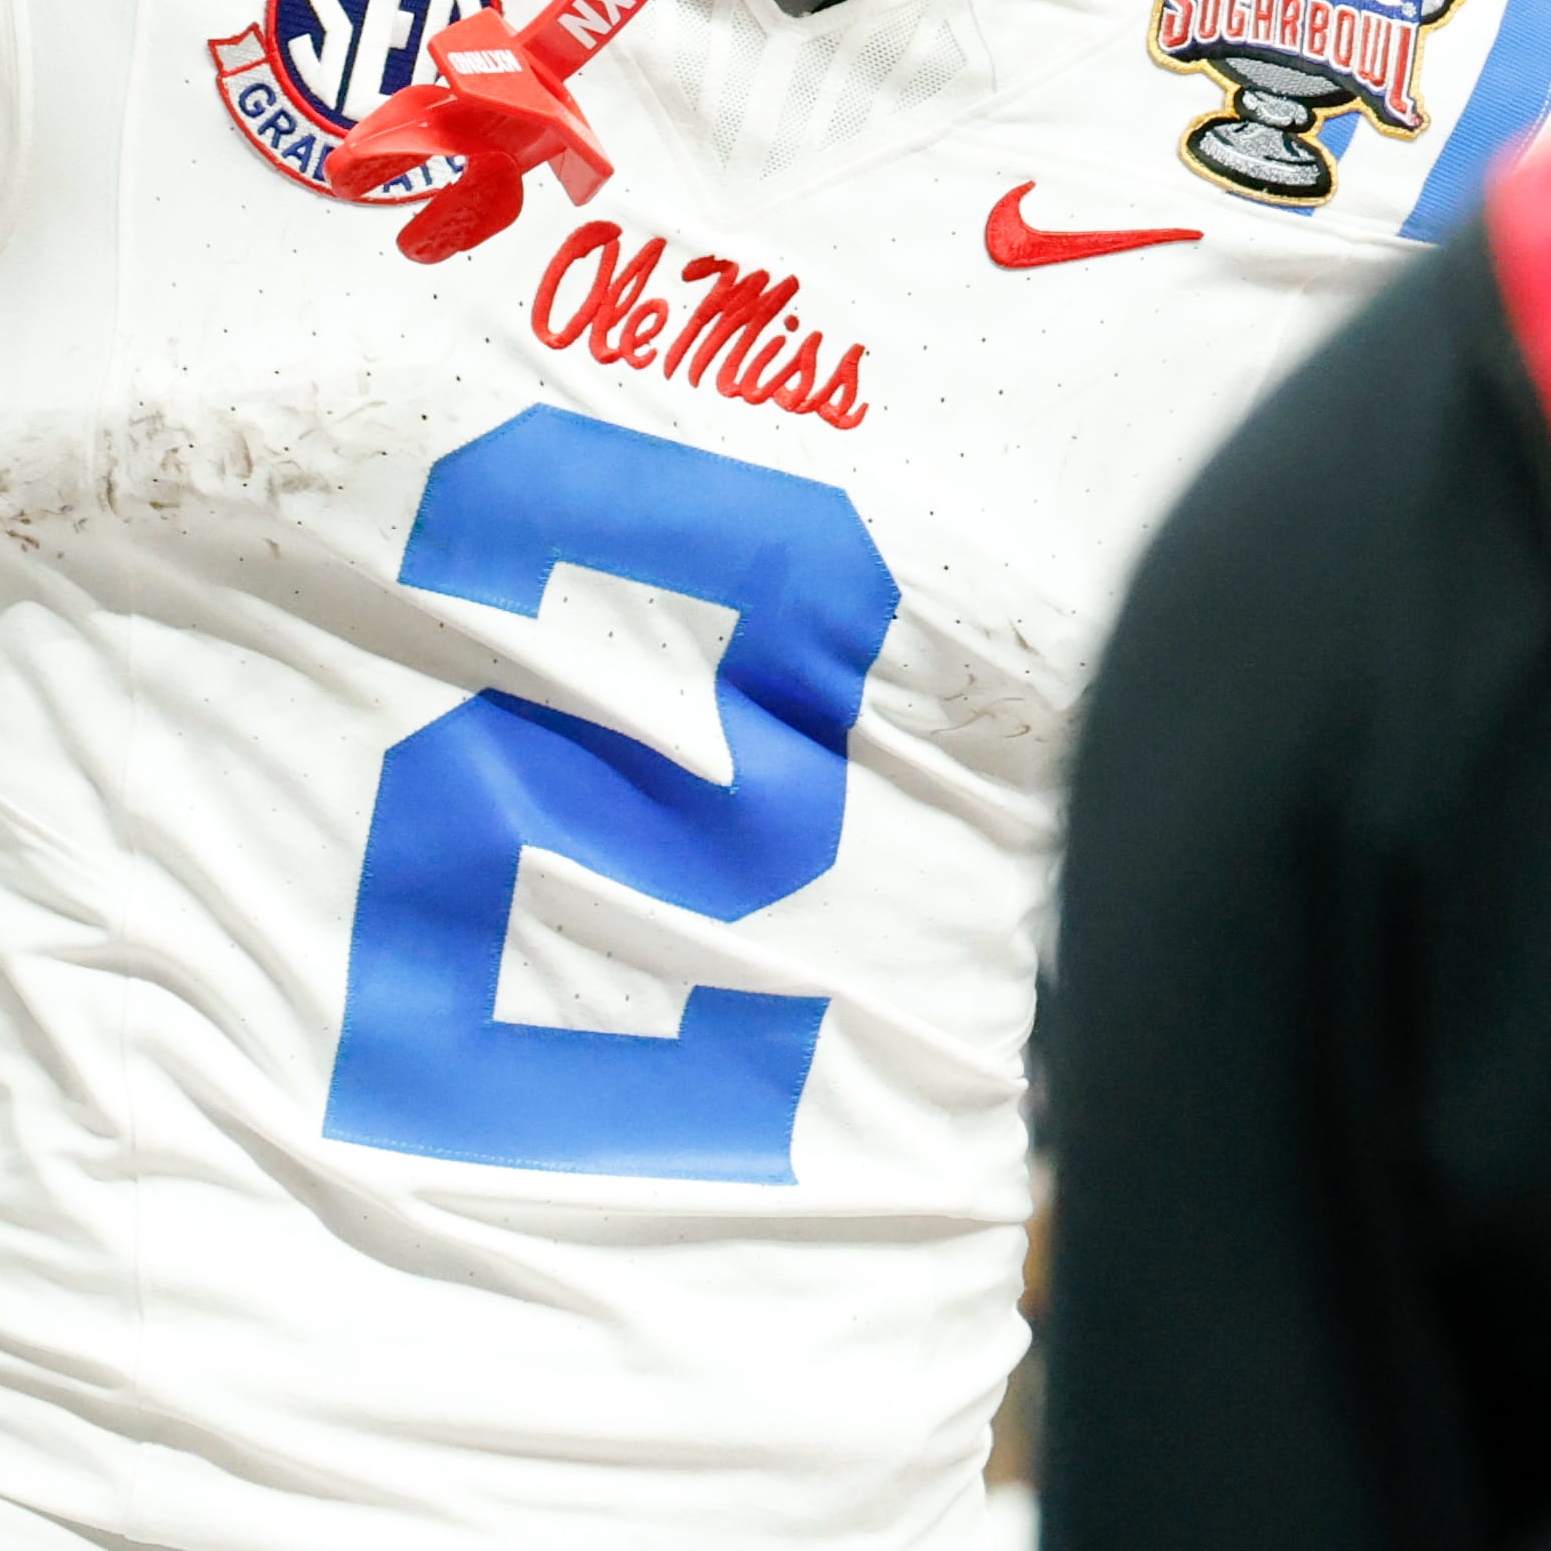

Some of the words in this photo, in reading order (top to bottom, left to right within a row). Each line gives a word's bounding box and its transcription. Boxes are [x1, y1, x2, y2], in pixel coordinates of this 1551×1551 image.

[531, 220, 667, 370] Ole
[664, 255, 870, 430] Miss
[322, 401, 901, 1185] 2
